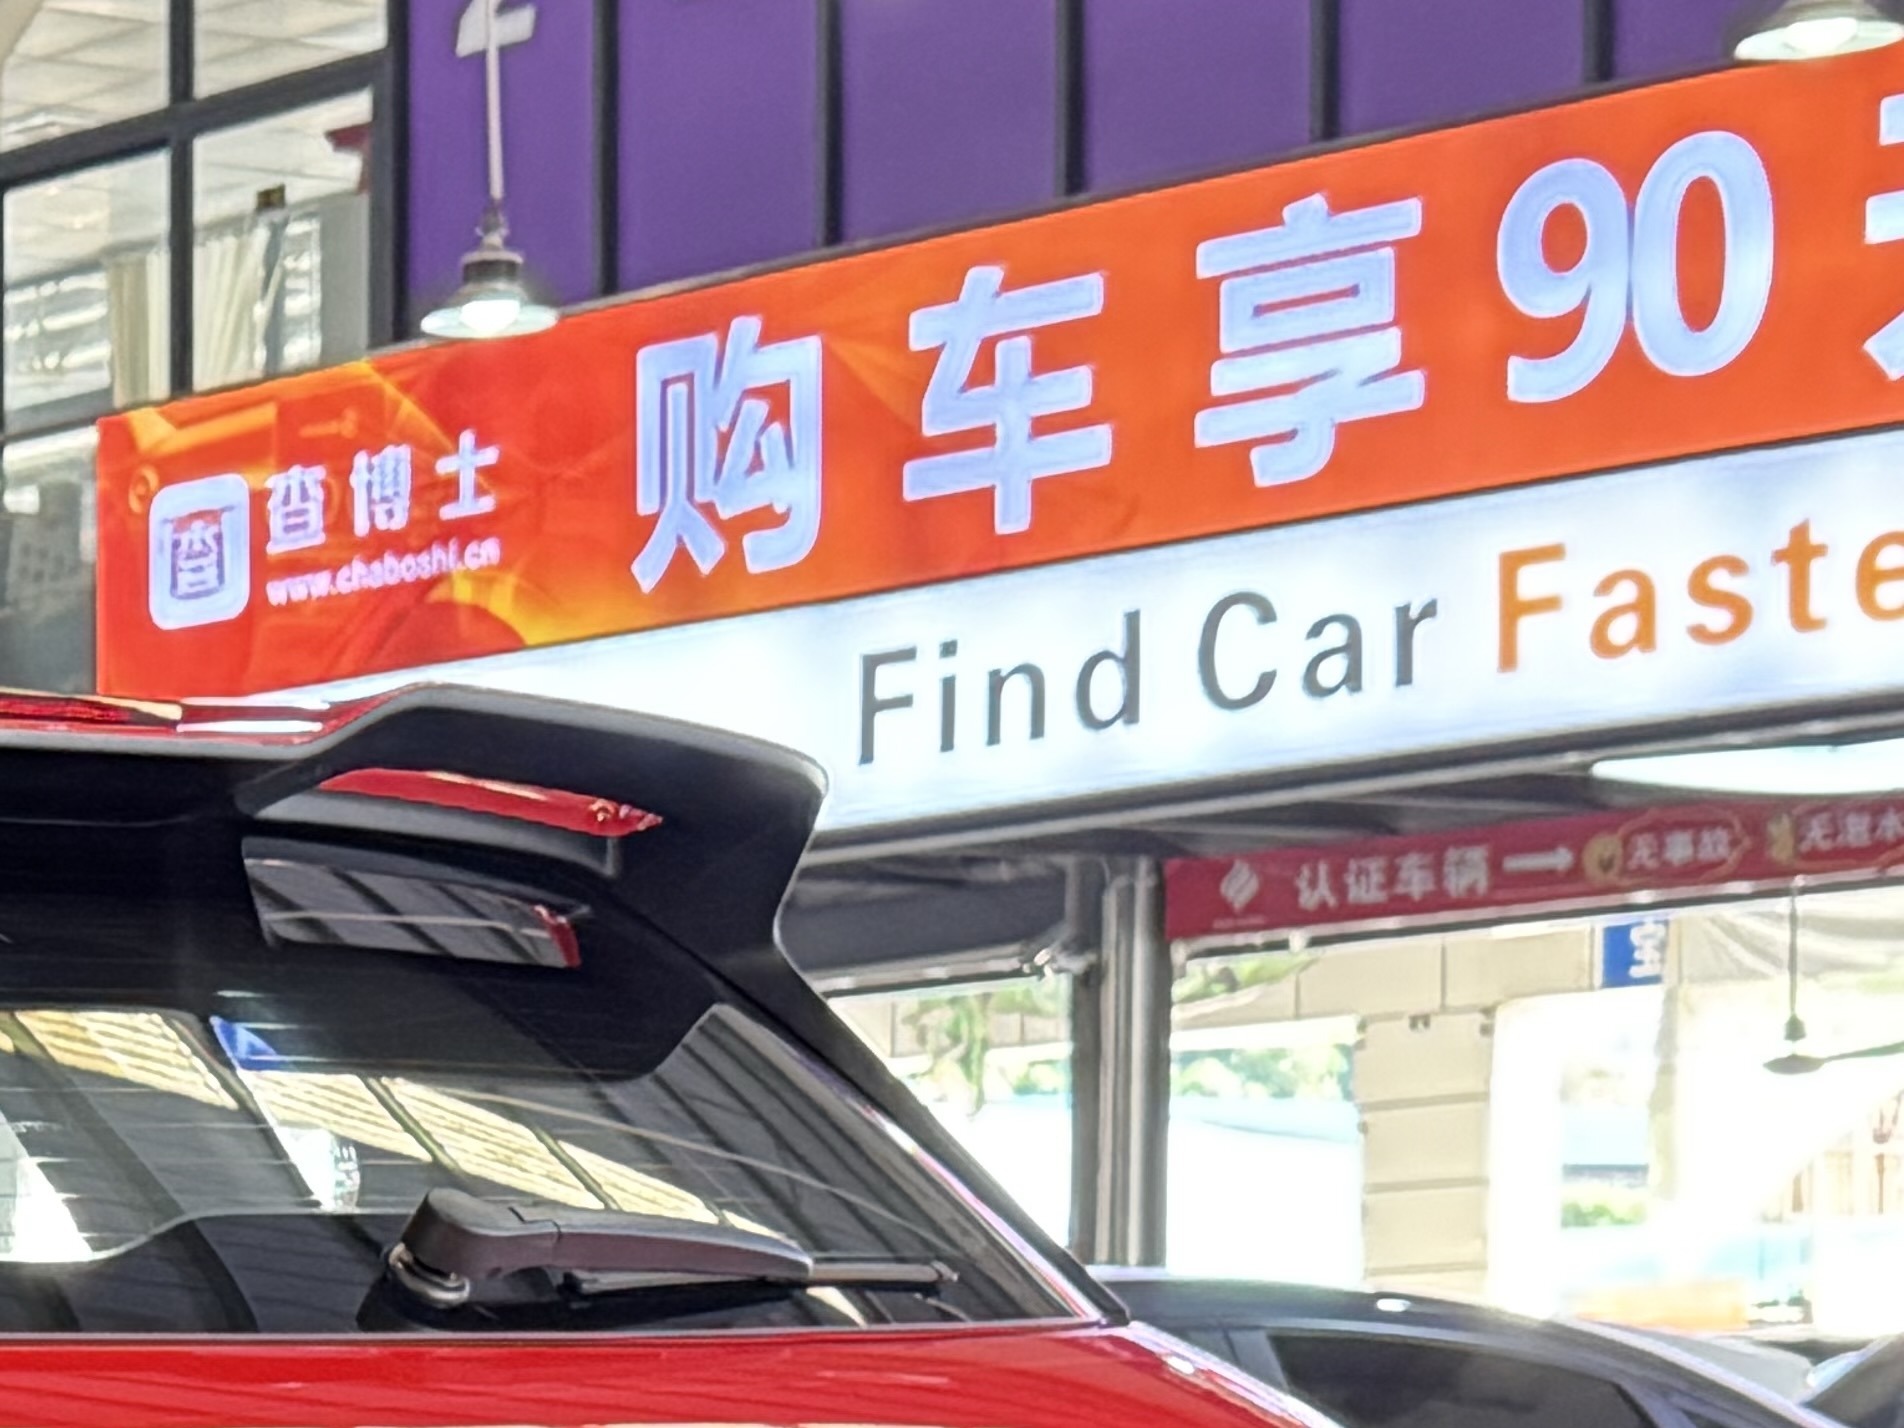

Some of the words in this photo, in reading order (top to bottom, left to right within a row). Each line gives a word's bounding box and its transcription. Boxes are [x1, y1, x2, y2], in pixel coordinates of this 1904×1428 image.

[857, 609, 1143, 767] Find
[1197, 589, 1439, 713] Car
[1295, 843, 1490, 912] 认证车辆
